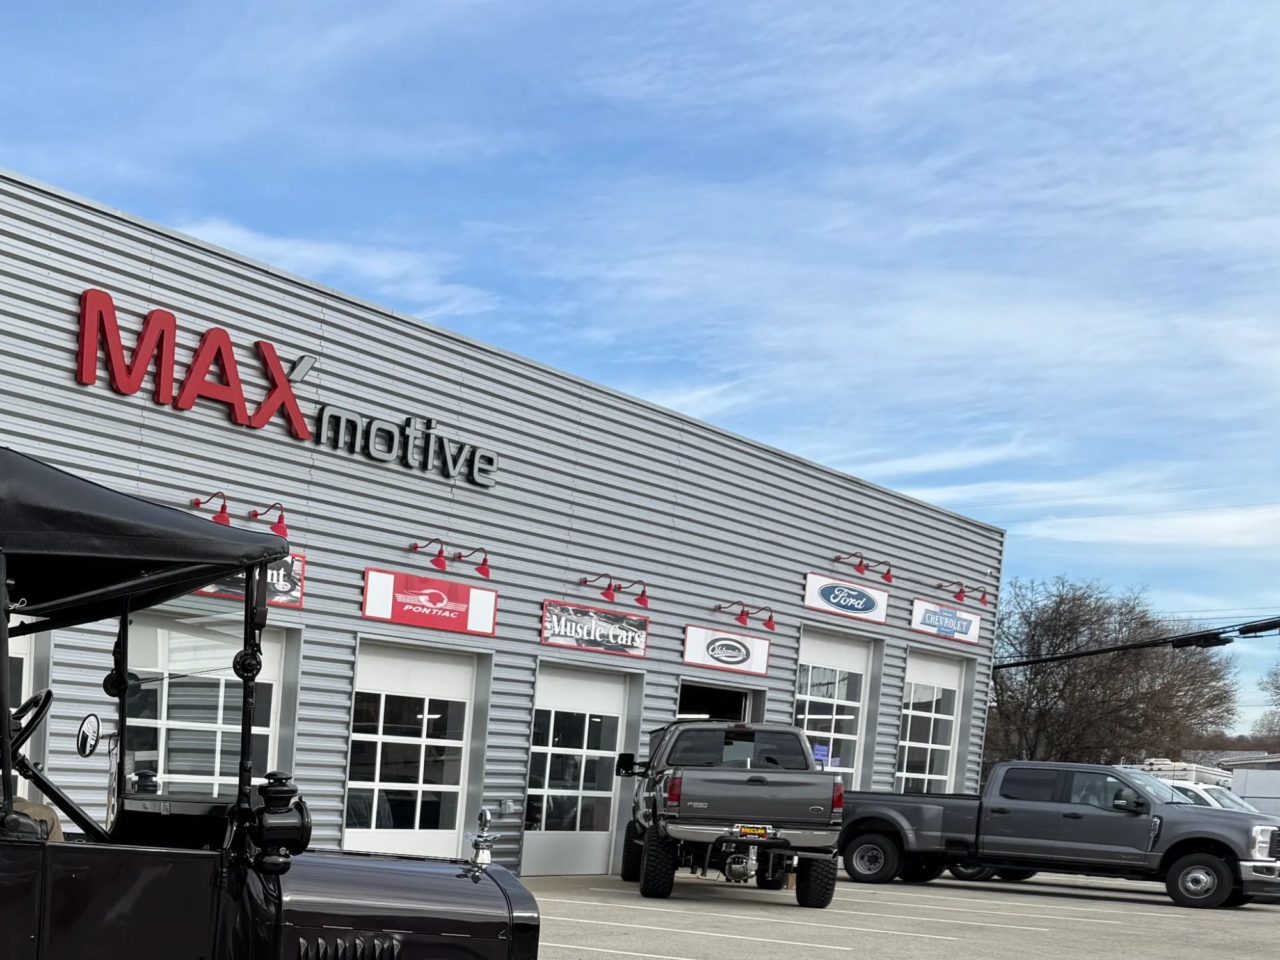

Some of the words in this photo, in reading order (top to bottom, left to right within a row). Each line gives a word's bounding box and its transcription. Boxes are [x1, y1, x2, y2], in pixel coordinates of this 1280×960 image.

[830, 587, 867, 610] Ford
[402, 604, 458, 619] PONTIAC
[550, 614, 603, 641] Muscle
[608, 623, 641, 646] Cars
[925, 613, 967, 631] CHEVROLET
